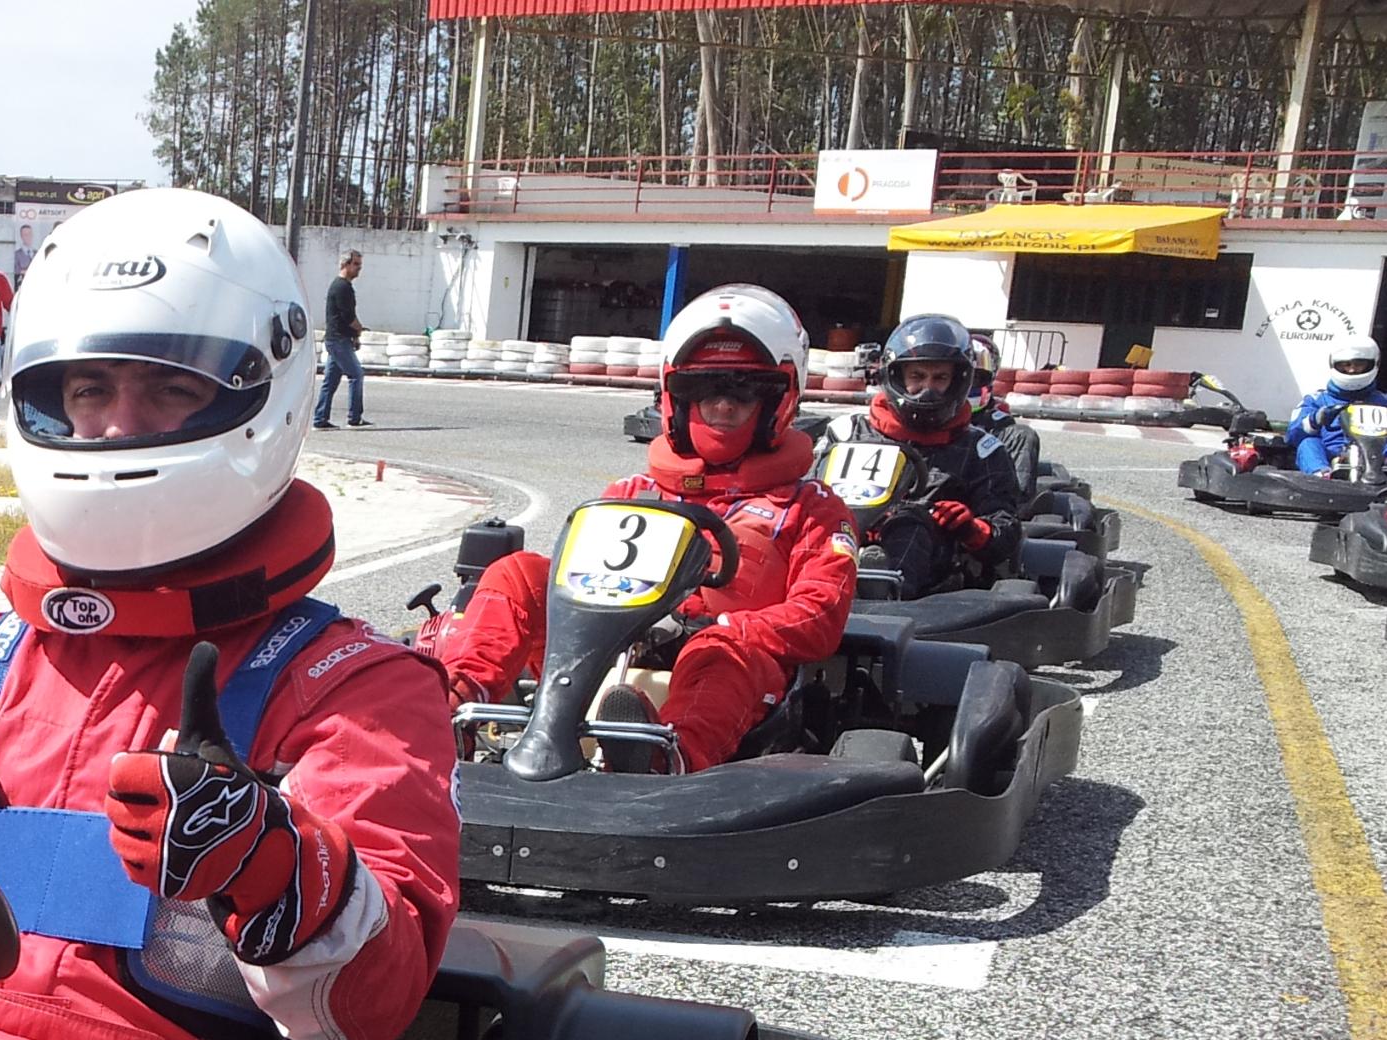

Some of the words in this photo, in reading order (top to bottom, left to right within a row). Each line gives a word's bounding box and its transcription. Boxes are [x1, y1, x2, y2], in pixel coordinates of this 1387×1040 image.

[1255, 300, 1303, 338] ESCOLA
[1280, 331, 1334, 341] EUROINDY
[840, 447, 882, 481] 14
[603, 513, 647, 571] 3
[69, 598, 98, 615] Top
[78, 614, 101, 623] one
[249, 616, 311, 669] sparco
[308, 641, 372, 679] sparco
